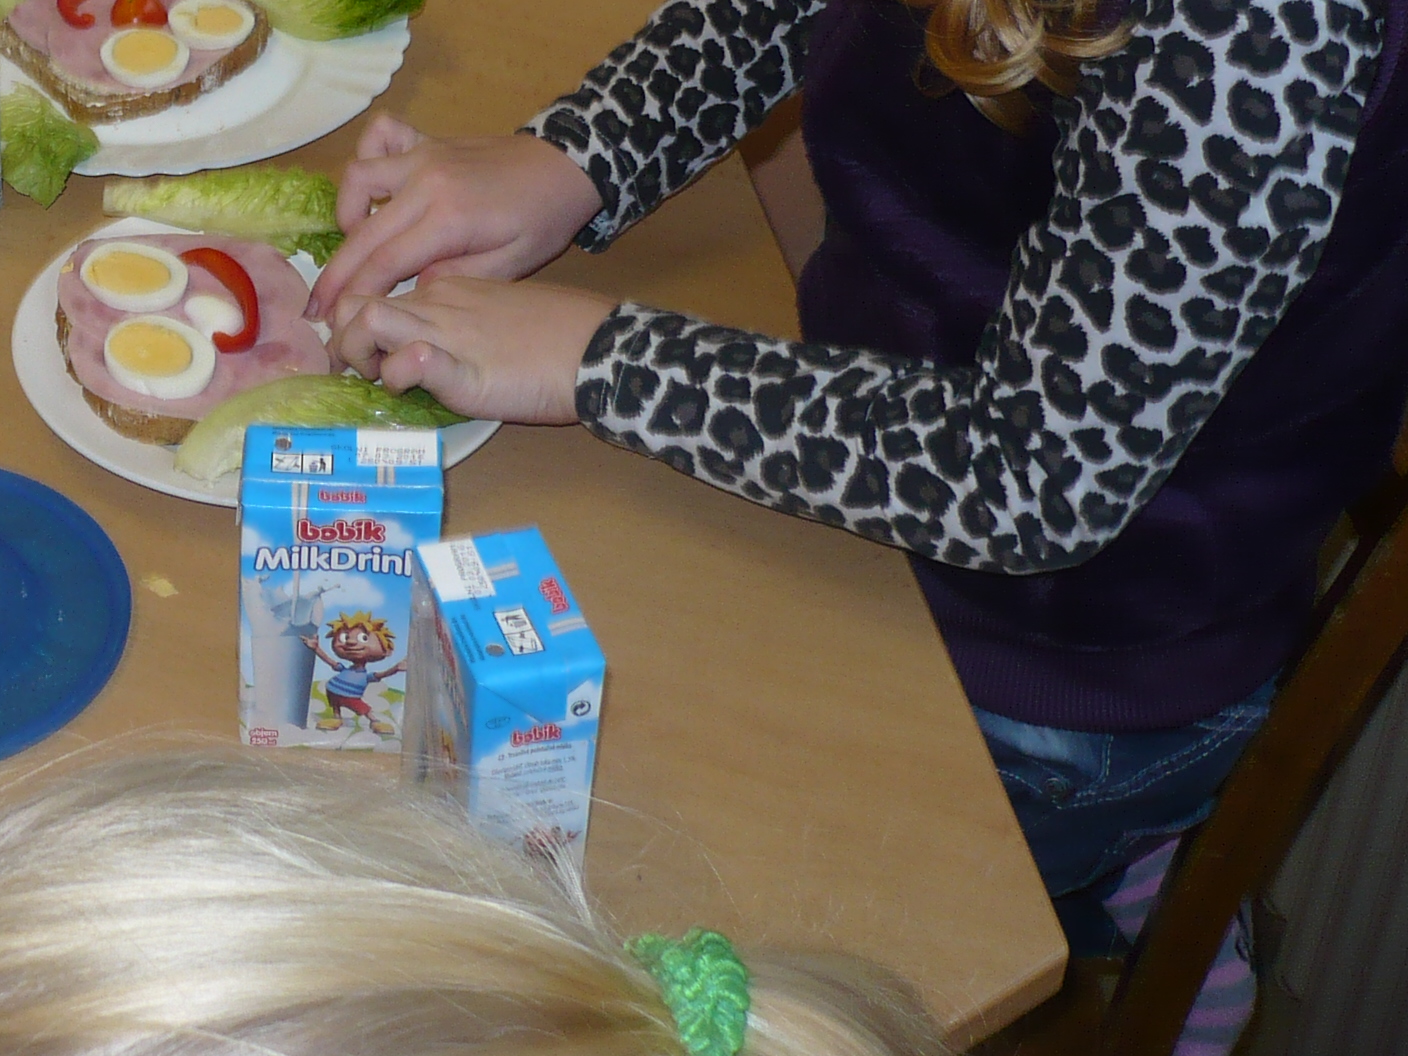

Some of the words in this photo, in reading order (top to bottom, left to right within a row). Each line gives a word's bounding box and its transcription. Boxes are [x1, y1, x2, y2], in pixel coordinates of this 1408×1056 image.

[317, 488, 367, 504] bobik
[296, 518, 385, 544] bobik
[538, 577, 570, 615] bobik
[510, 723, 562, 748] bobik
